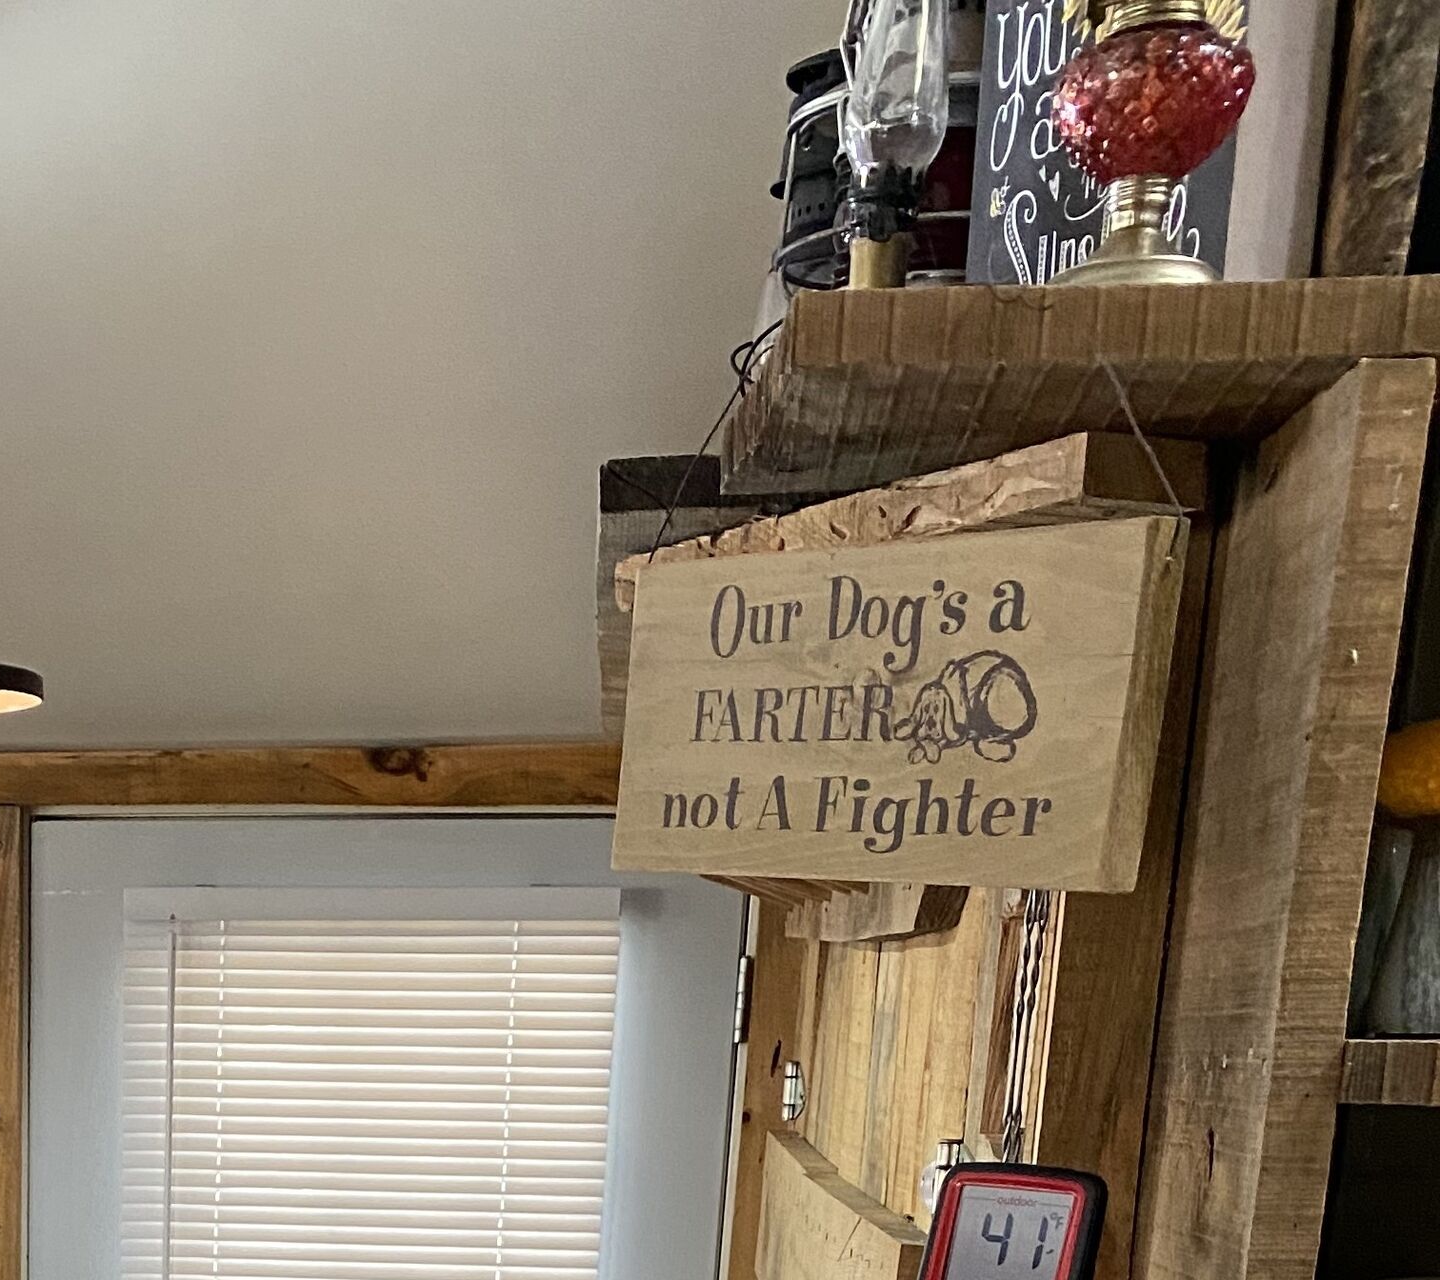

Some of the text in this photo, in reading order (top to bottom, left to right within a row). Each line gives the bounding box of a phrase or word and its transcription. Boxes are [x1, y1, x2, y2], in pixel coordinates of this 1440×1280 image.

[710, 575, 1032, 673] Our Dog's a
[690, 683, 894, 743] FARTER
[662, 775, 1052, 854] not A Fighter
[981, 1212, 1049, 1270] 41
